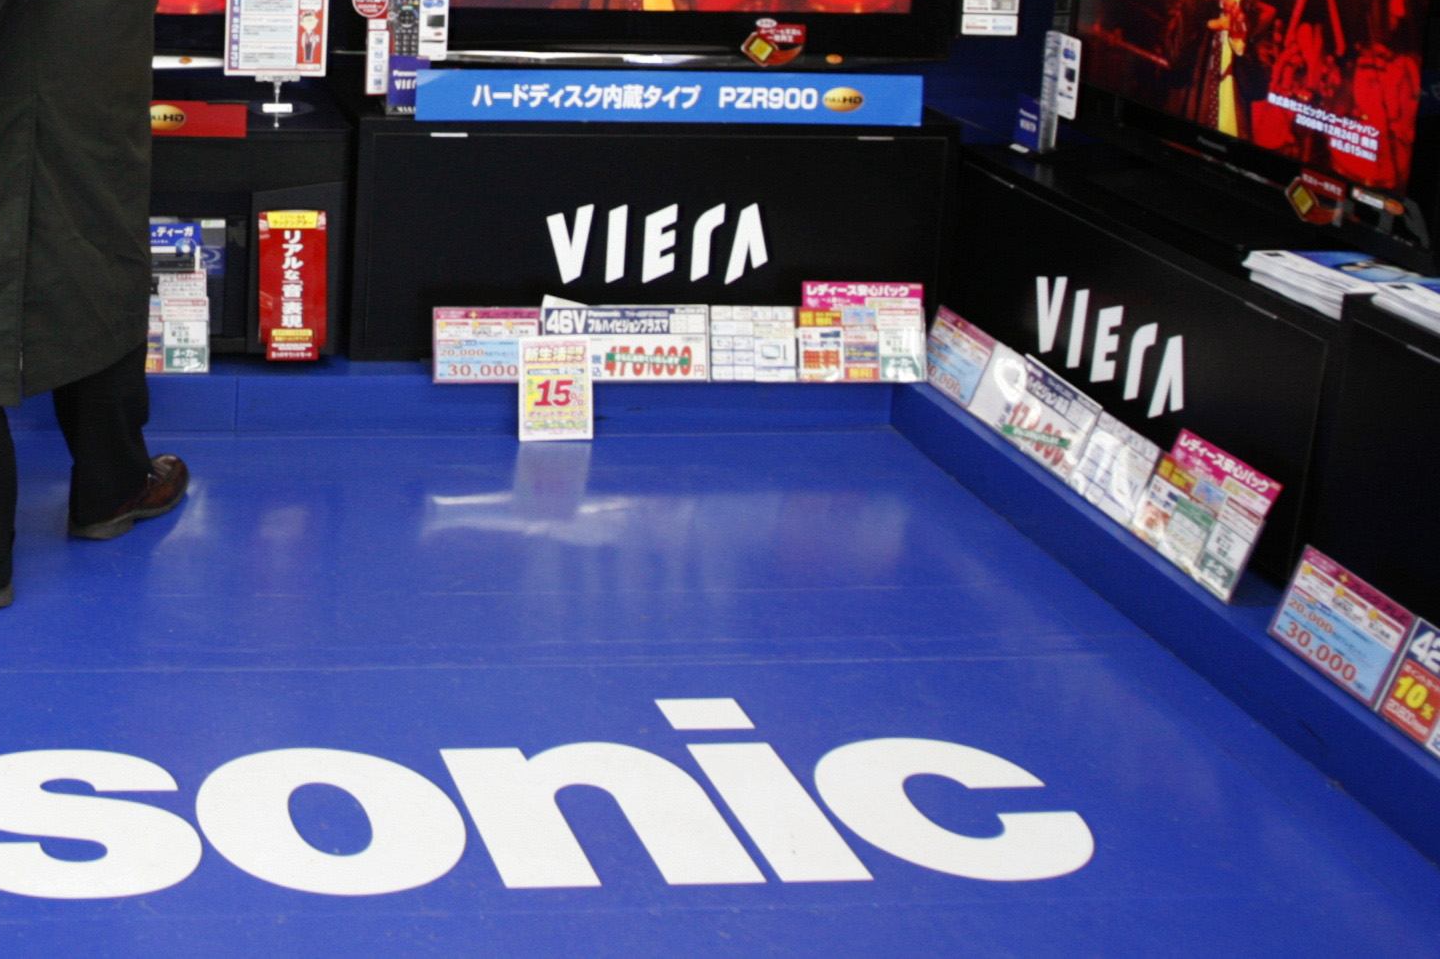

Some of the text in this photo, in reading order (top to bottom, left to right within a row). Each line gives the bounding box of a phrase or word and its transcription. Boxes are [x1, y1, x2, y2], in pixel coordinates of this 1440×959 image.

[471, 84, 818, 110] ハードディスク内蔵タイプ PZR900
[545, 202, 769, 285] VIERA
[545, 309, 587, 334] 46V
[1035, 275, 1185, 419] VIERA
[448, 363, 518, 378] 30,000
[534, 379, 574, 407] 15
[1285, 618, 1358, 682] 30,000
[1394, 674, 1436, 720] 10%
